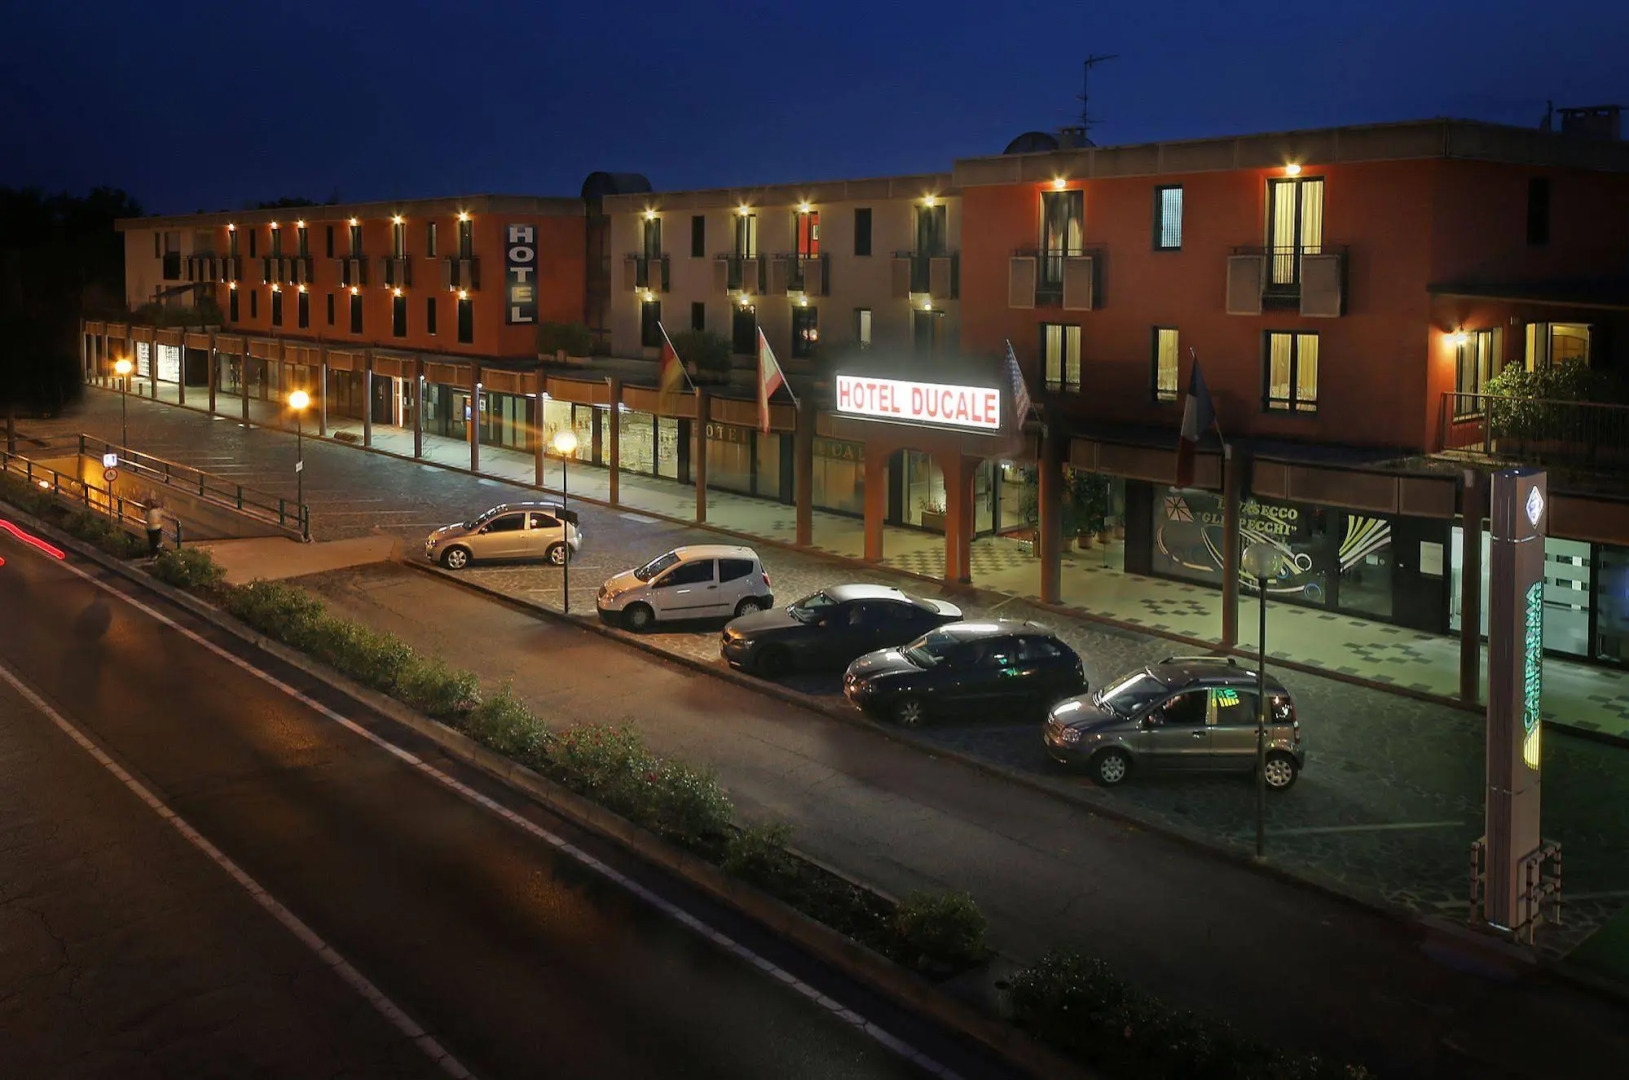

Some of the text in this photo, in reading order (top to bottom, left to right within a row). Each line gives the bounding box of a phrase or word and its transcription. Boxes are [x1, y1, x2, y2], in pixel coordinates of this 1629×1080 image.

[508, 226, 535, 323] HOTEL
[839, 380, 996, 424] HOTEL DUCALE
[1215, 497, 1298, 520] LVASECCO
[1239, 518, 1297, 534] PECCHI"
